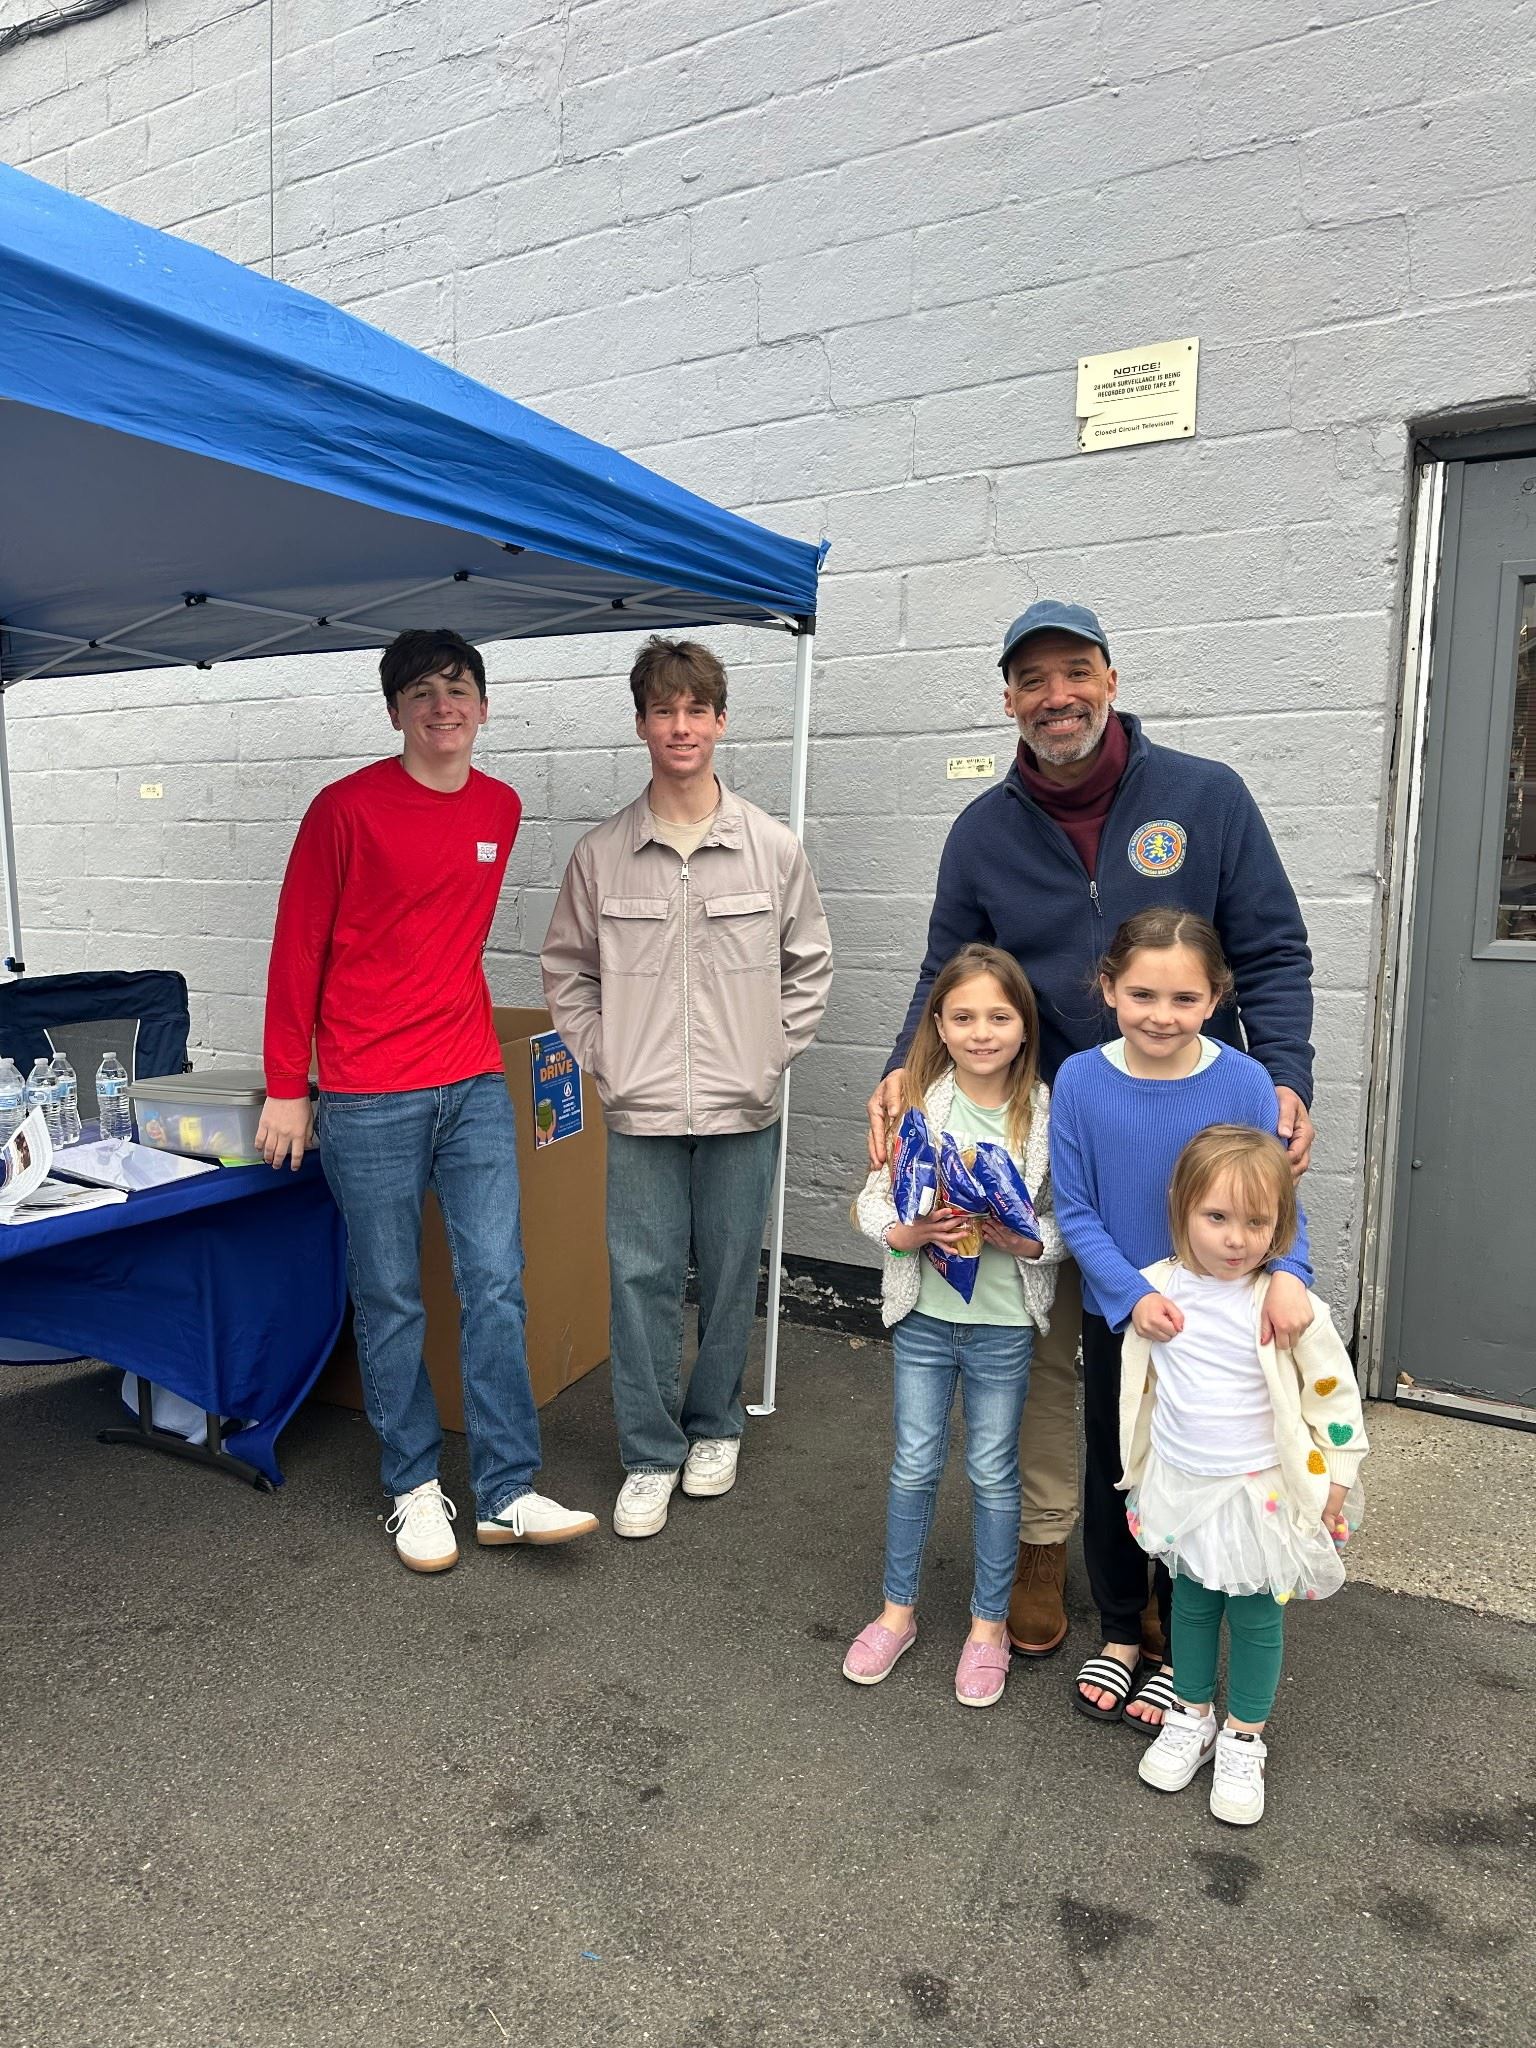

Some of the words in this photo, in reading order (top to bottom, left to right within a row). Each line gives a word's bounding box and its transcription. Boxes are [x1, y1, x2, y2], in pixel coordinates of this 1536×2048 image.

[1113, 362, 1161, 375] NOTICE!
[1093, 383, 1101, 391] 24
[1101, 381, 1116, 390] HOUR
[1117, 375, 1156, 387] SURVEILLANCE
[1164, 371, 1181, 379] BEING
[1097, 388, 1126, 398] RECORDED
[1153, 382, 1167, 390] TAPE
[1094, 427, 1117, 437] Closed
[1118, 424, 1140, 433] Circuit
[1142, 420, 1174, 429] Television
[540, 1059, 572, 1082] DRIVE
